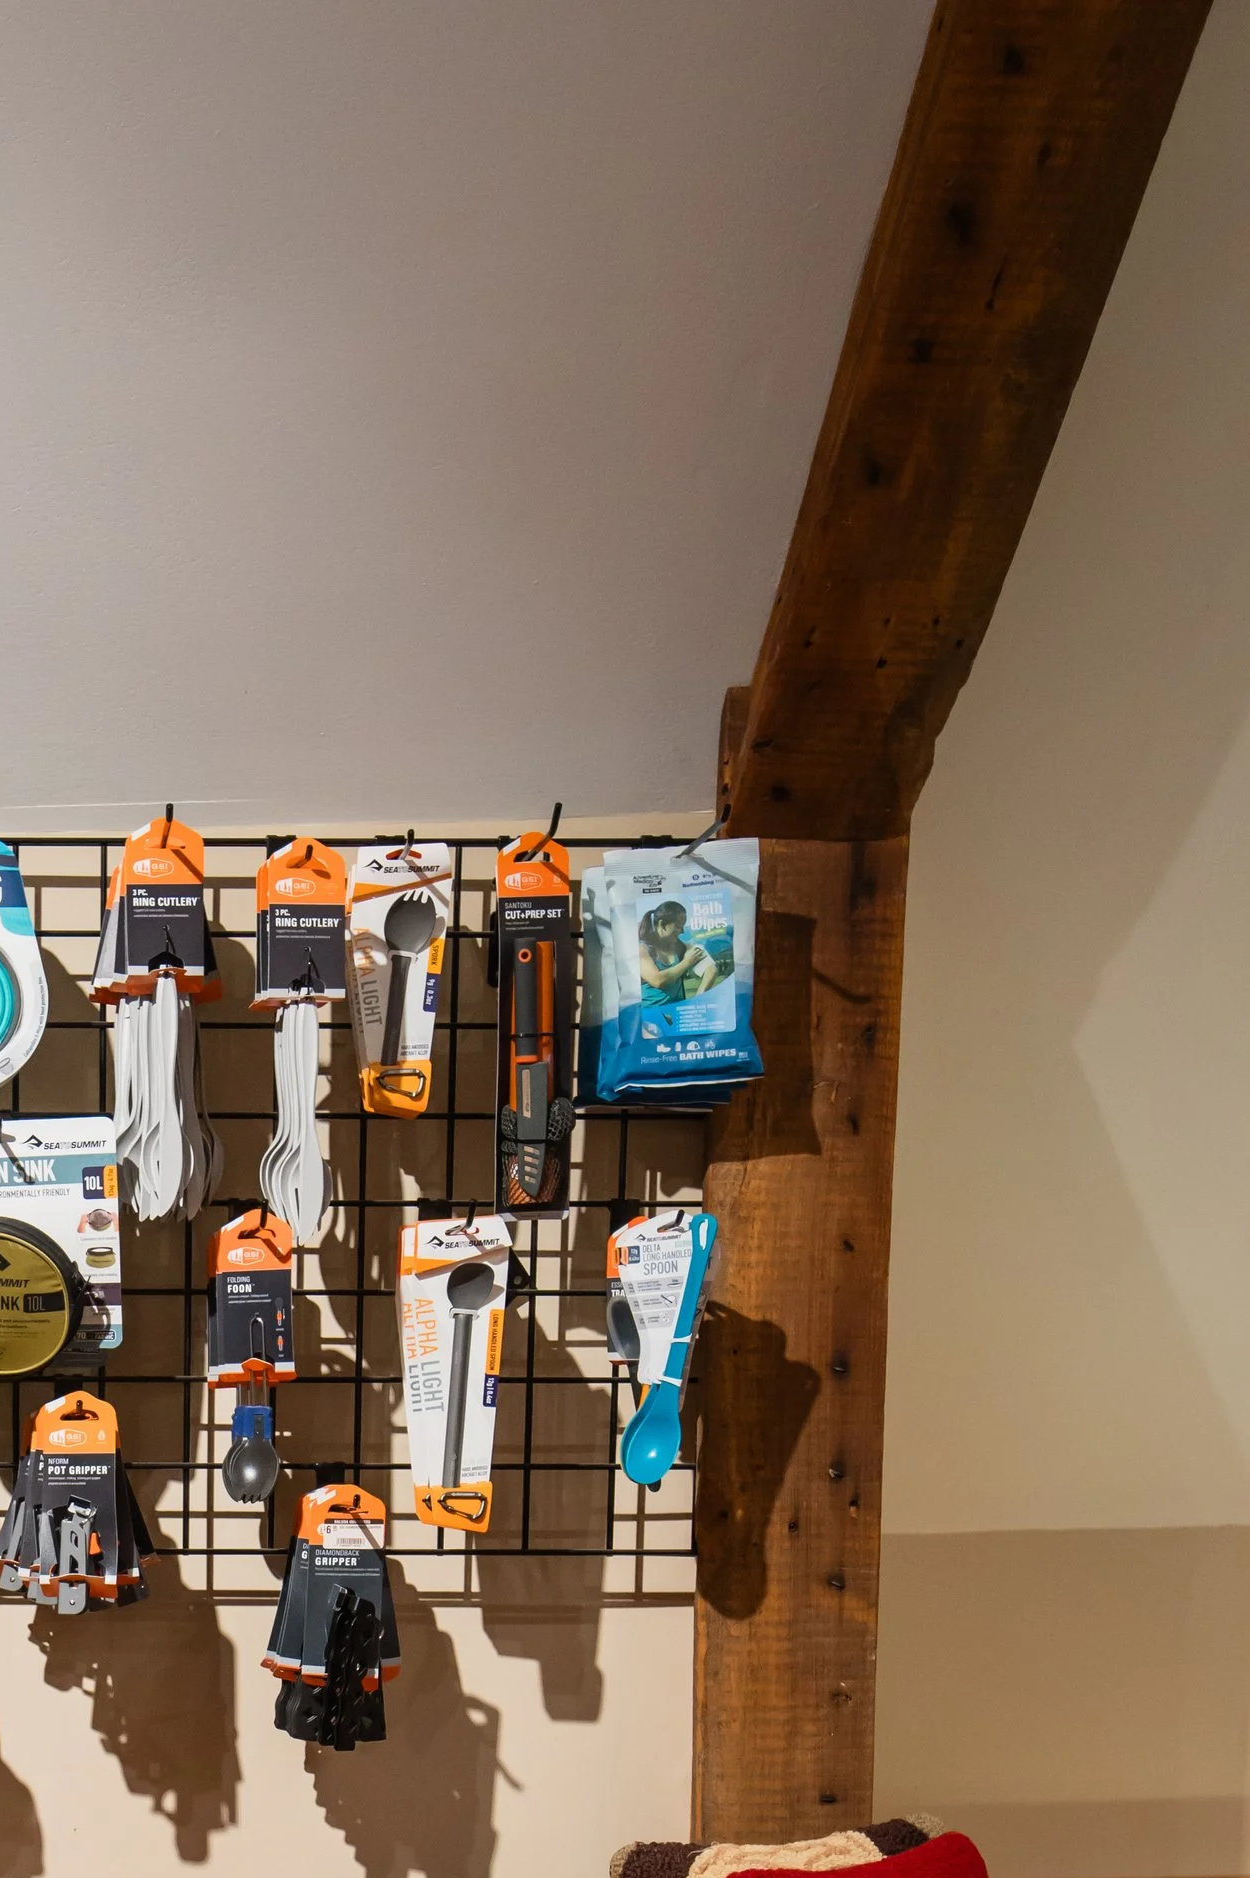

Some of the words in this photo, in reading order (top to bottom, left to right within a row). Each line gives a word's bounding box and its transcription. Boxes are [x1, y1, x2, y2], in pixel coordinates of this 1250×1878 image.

[133, 897, 156, 907] RING
[157, 896, 198, 907] CUTLERY
[504, 902, 532, 910] SANTOKU
[505, 909, 546, 920] CUT+PREP
[547, 909, 562, 919] SET
[693, 901, 723, 916] Bath
[275, 917, 298, 928] RING
[299, 917, 340, 928] CUTLERY
[690, 917, 728, 931] Wipes
[430, 944, 440, 966] SPORK
[361, 979, 383, 1025] LIGHT
[640, 1054, 678, 1064] Rinse-Free
[679, 1052, 704, 1061] BATH
[706, 1049, 737, 1059] WIPES
[13, 1158, 57, 1184] SINK
[83, 1175, 104, 1191] 10L
[42, 1187, 71, 1197] FRIENDLY
[642, 1244, 661, 1252] DELTA
[642, 1251, 660, 1261] LONG
[660, 1249, 692, 1259] HANDLED
[643, 1260, 679, 1275] SPOON
[227, 1276, 251, 1284] FOLDING
[227, 1284, 252, 1294] FOON
[27, 1295, 47, 1312] 10L
[414, 1298, 440, 1357] ALPHA
[421, 1360, 446, 1413] LIGHT
[48, 1465, 67, 1475] POT
[68, 1465, 108, 1475] GRIPPER
[315, 1556, 358, 1567] GRIPPER
